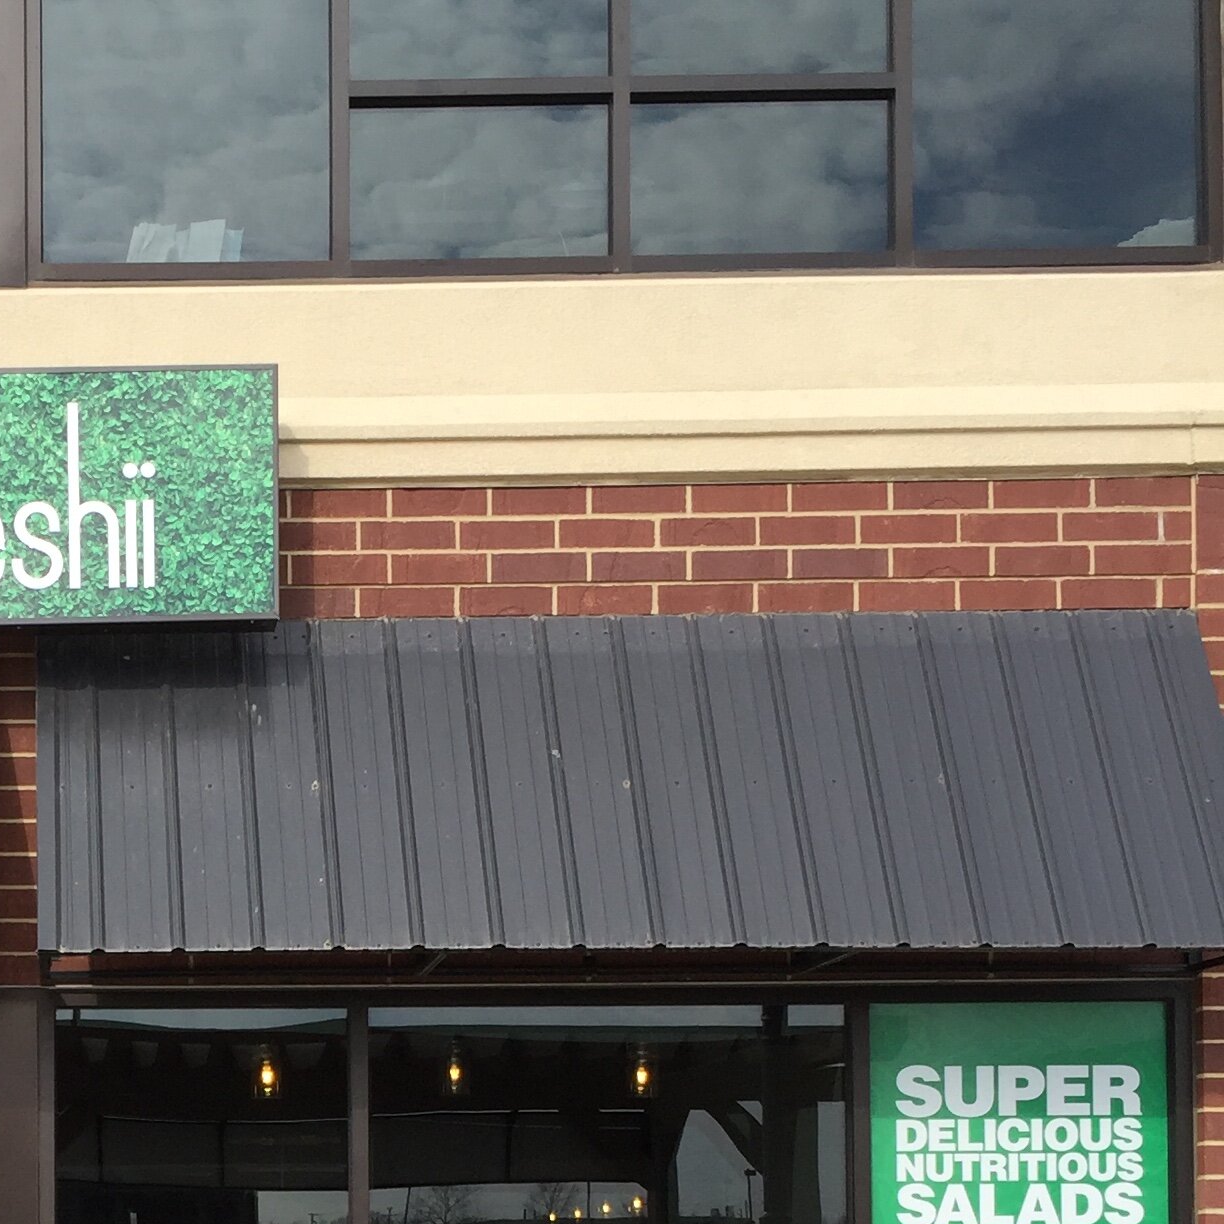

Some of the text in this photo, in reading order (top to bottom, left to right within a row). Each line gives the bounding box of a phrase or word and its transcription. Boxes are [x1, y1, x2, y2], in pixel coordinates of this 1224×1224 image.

[895, 1065, 1143, 1118] SUPER
[896, 1118, 1143, 1152] DELICIOUS
[896, 1152, 1144, 1182] NUTRITIOUS
